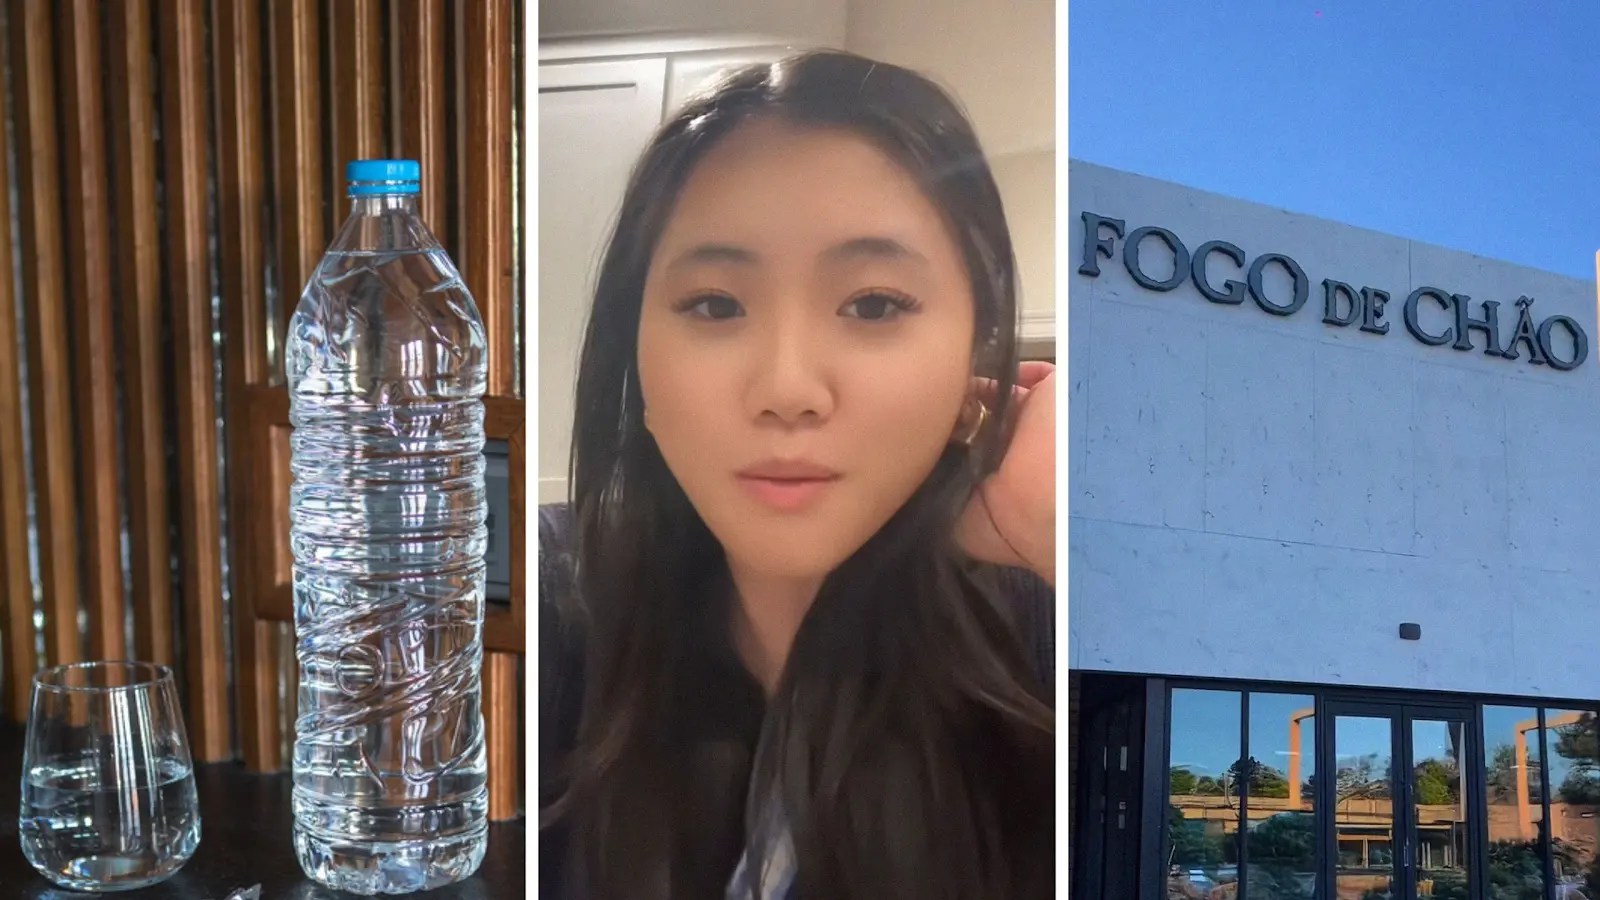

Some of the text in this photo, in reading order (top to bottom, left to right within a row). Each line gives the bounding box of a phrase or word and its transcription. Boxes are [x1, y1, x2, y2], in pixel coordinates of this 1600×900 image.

[1078, 211, 1588, 371] FOGO DE CHÃO
